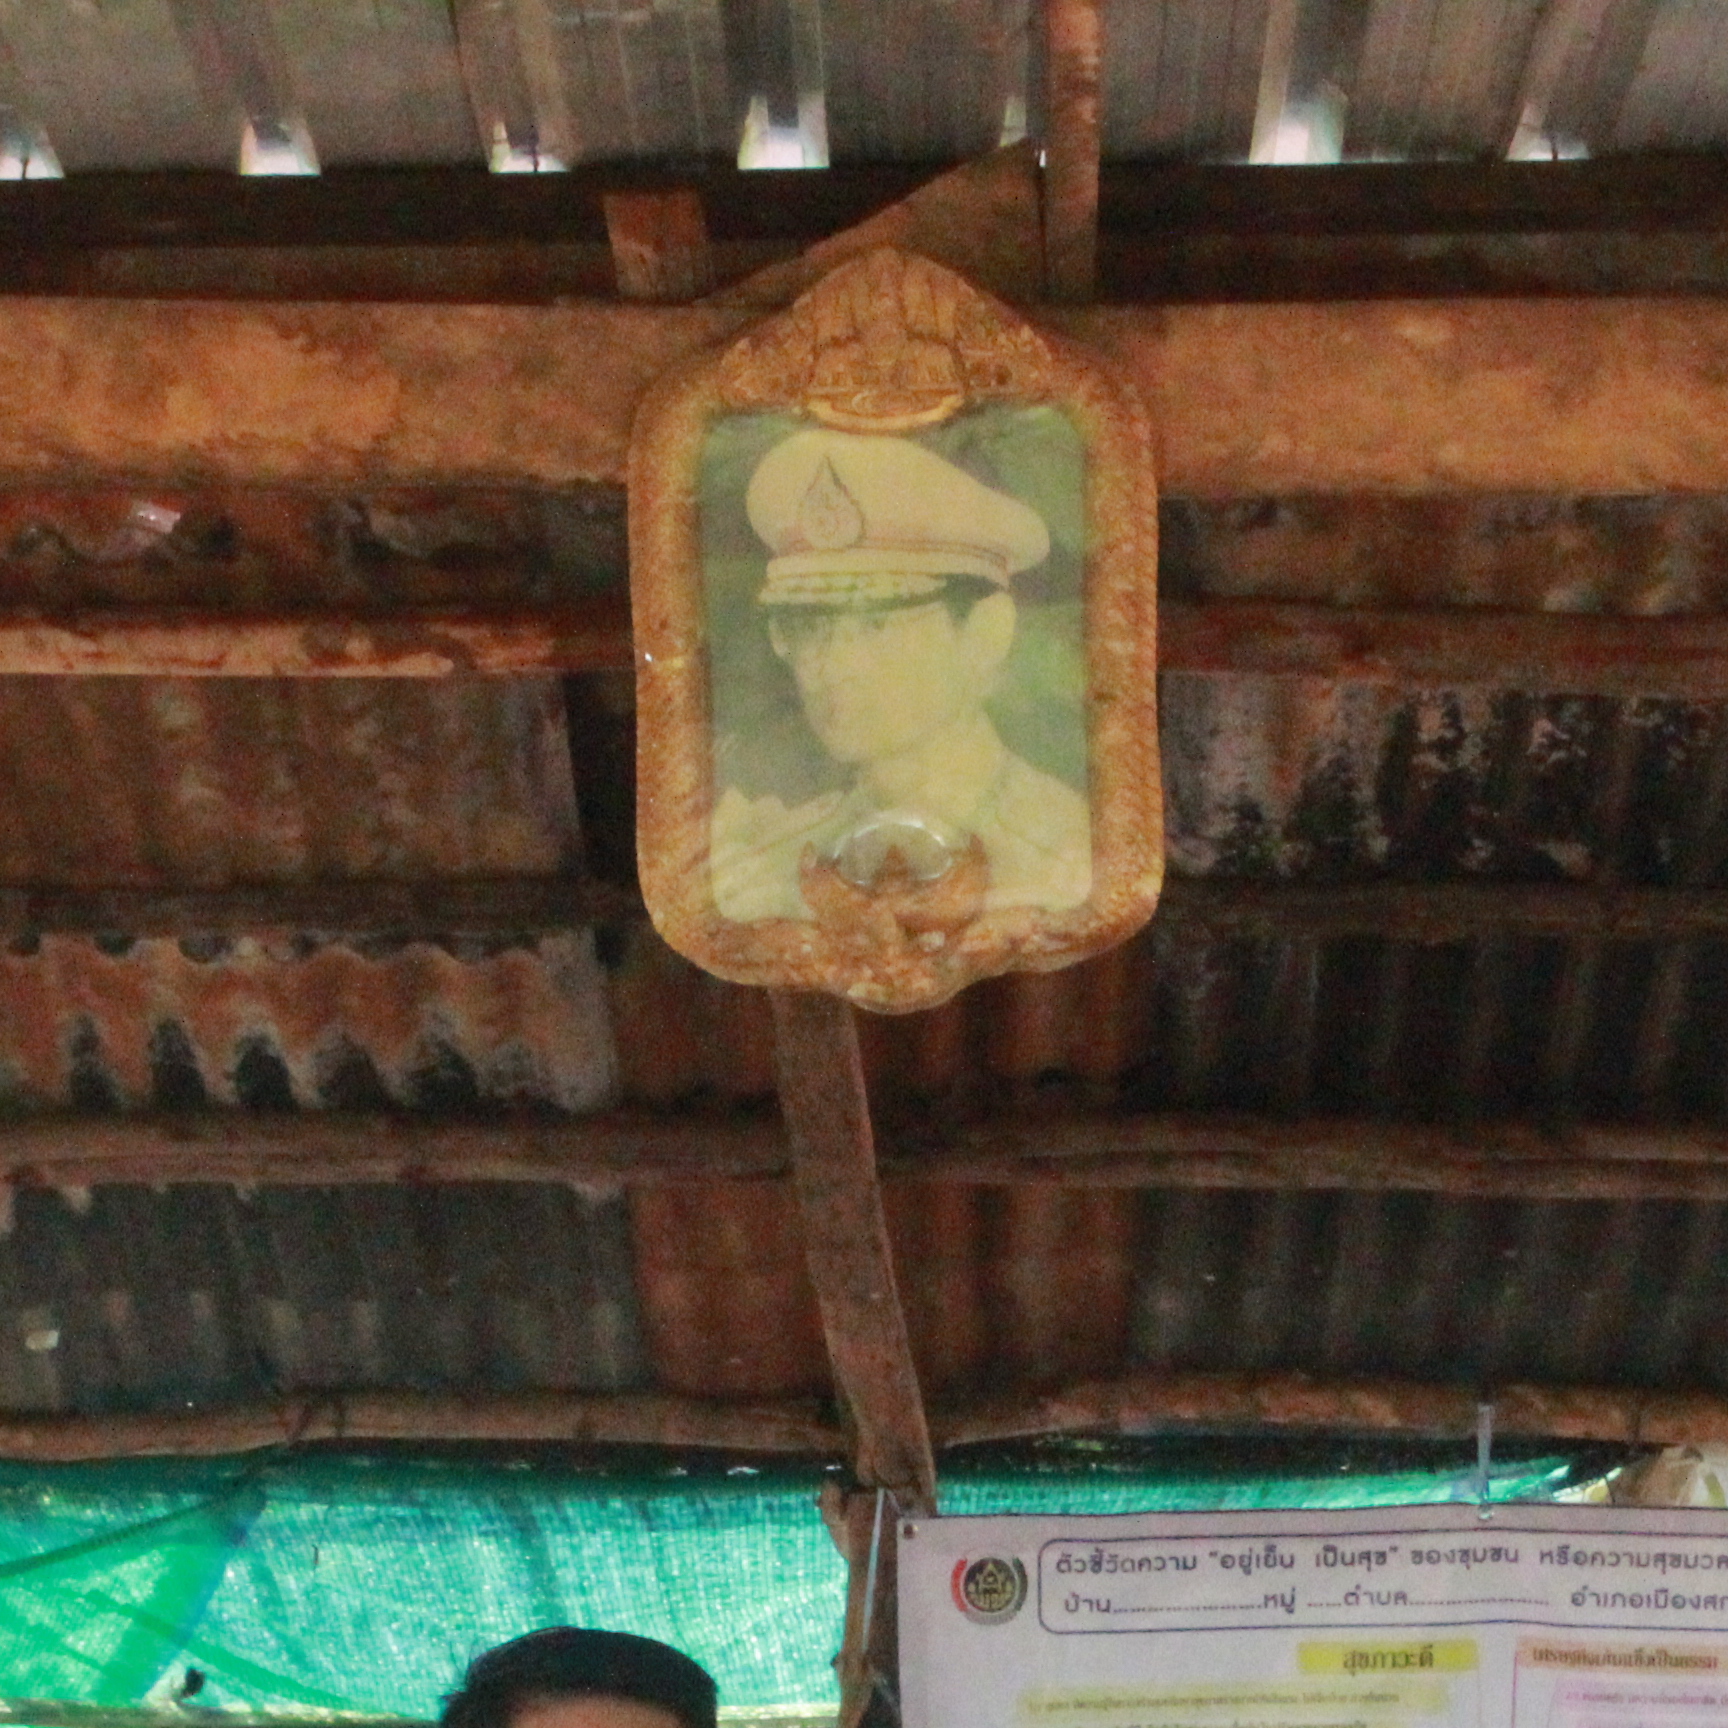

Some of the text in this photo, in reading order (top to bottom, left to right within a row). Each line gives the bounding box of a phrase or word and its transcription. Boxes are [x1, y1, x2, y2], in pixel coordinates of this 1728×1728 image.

[1056, 1546, 1197, 1574] ตัวชี้วัดความ
[1411, 1547, 1519, 1570] ของชุมชน
[1343, 1644, 1434, 1676] สุขภาวะดี
